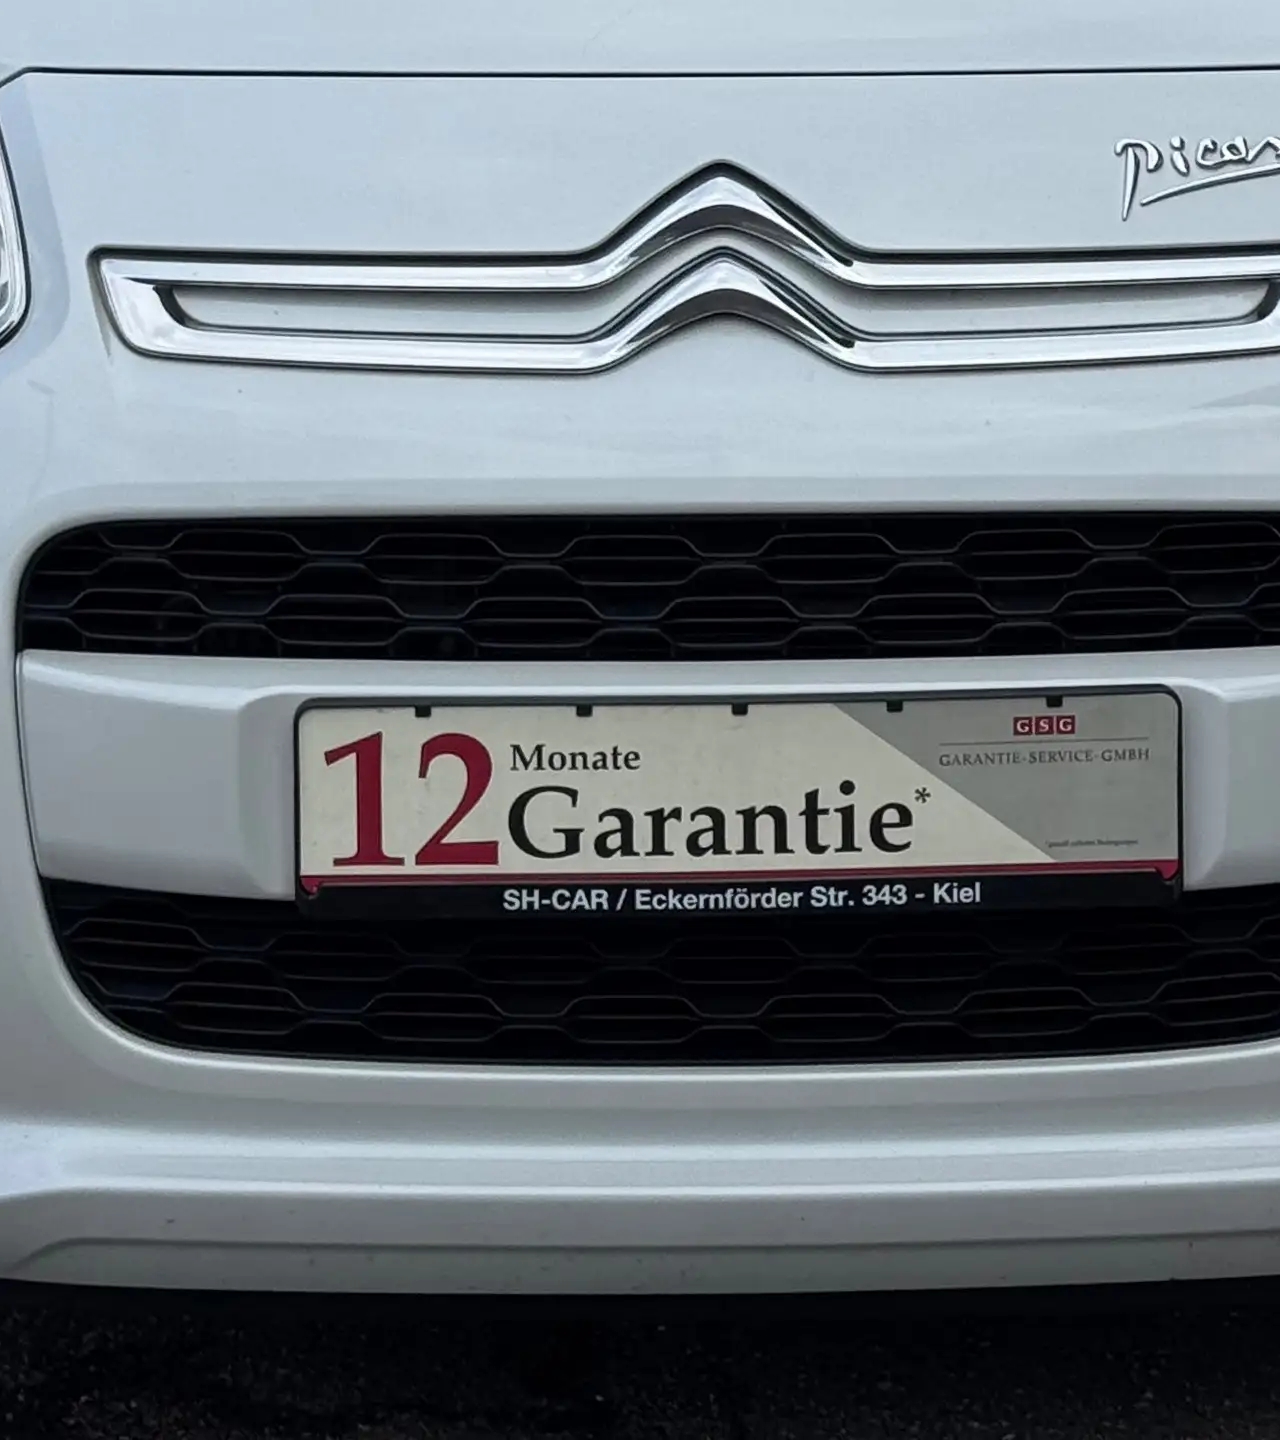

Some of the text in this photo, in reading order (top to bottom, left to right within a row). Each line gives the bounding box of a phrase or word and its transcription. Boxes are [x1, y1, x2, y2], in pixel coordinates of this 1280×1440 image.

[1015, 716, 1075, 735] GSG
[509, 743, 641, 772] Monate
[324, 731, 499, 866] 12
[503, 888, 609, 911] SH-CAR
[616, 888, 627, 911] /
[634, 886, 803, 911] Eckernförder
[810, 885, 855, 908] Str.
[862, 883, 908, 906] 343
[933, 881, 981, 905] Kiel
